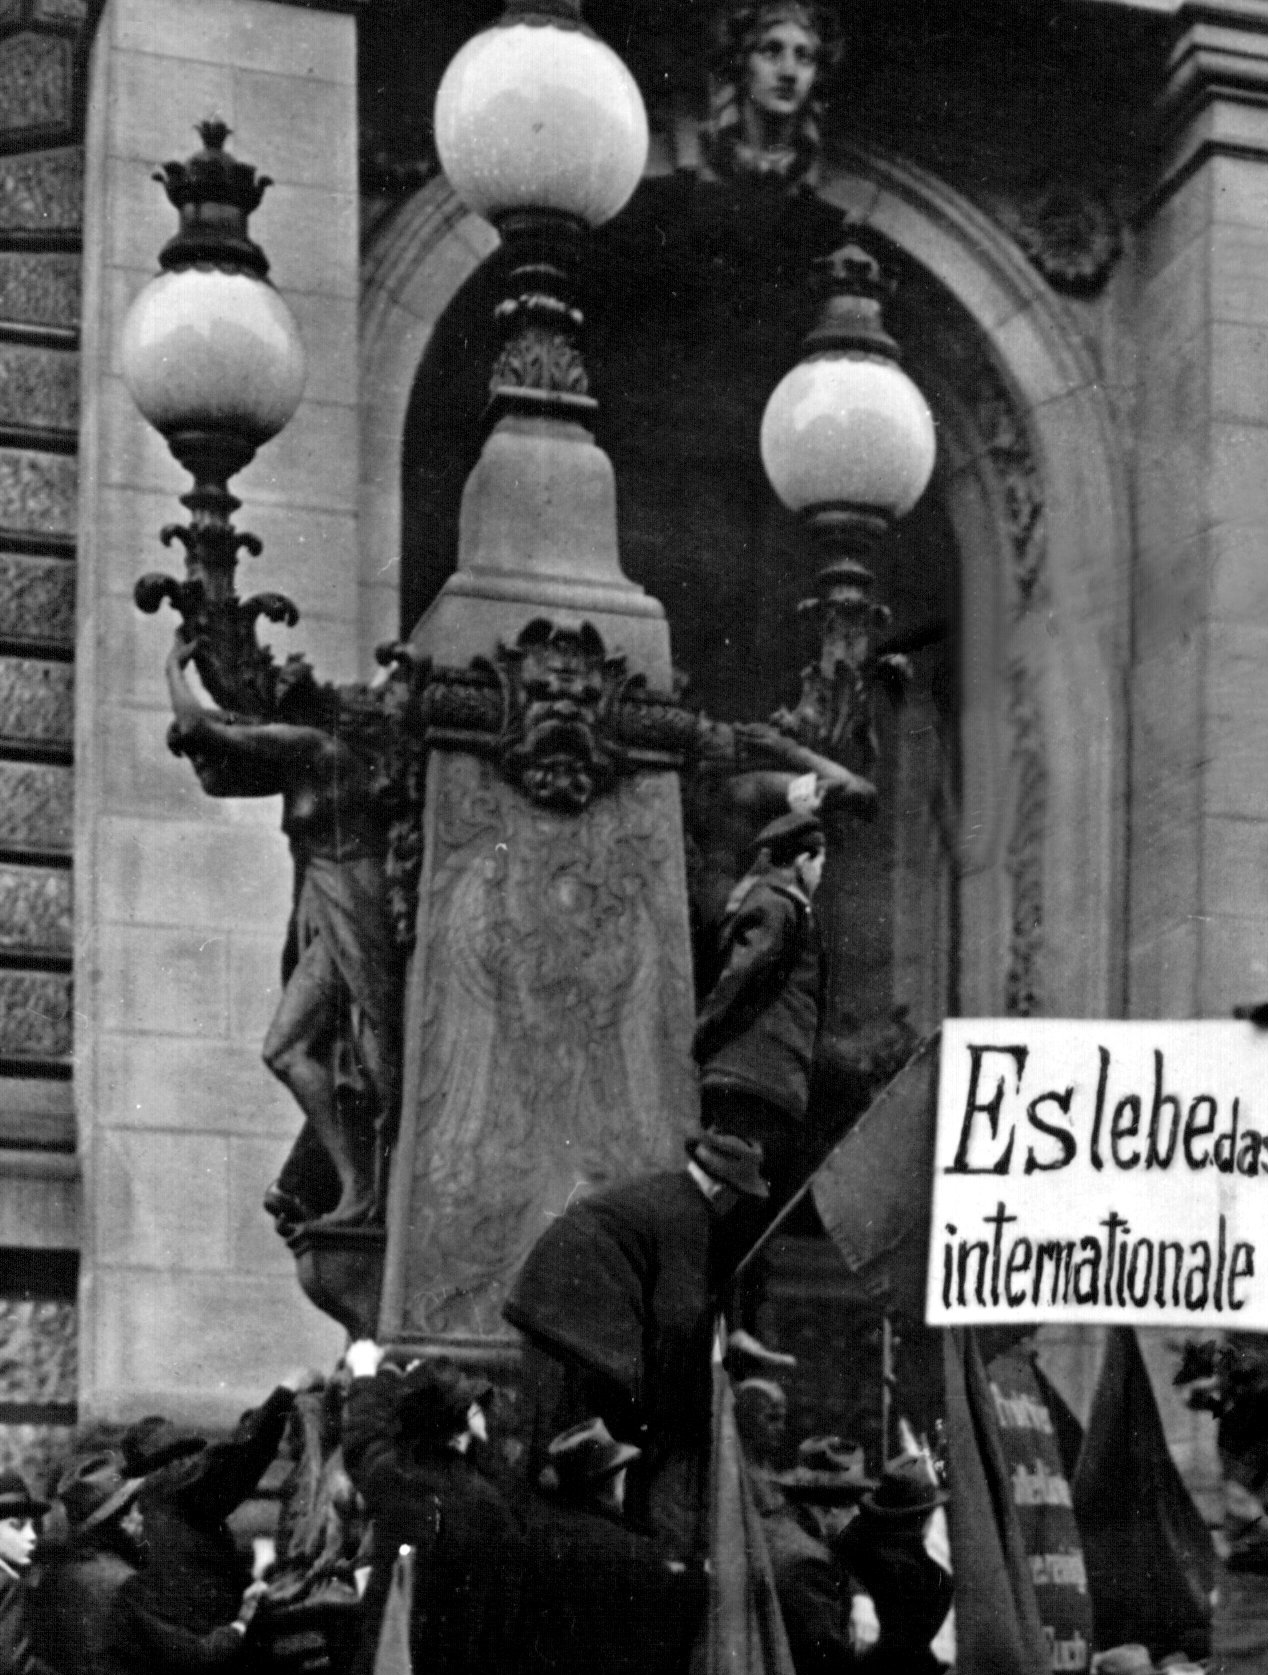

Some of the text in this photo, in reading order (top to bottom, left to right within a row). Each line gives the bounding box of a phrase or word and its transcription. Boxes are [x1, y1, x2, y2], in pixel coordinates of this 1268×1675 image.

[944, 1043, 1077, 1176] Es
[1090, 1045, 1218, 1172] lebe
[942, 1201, 1255, 1312] internationale
